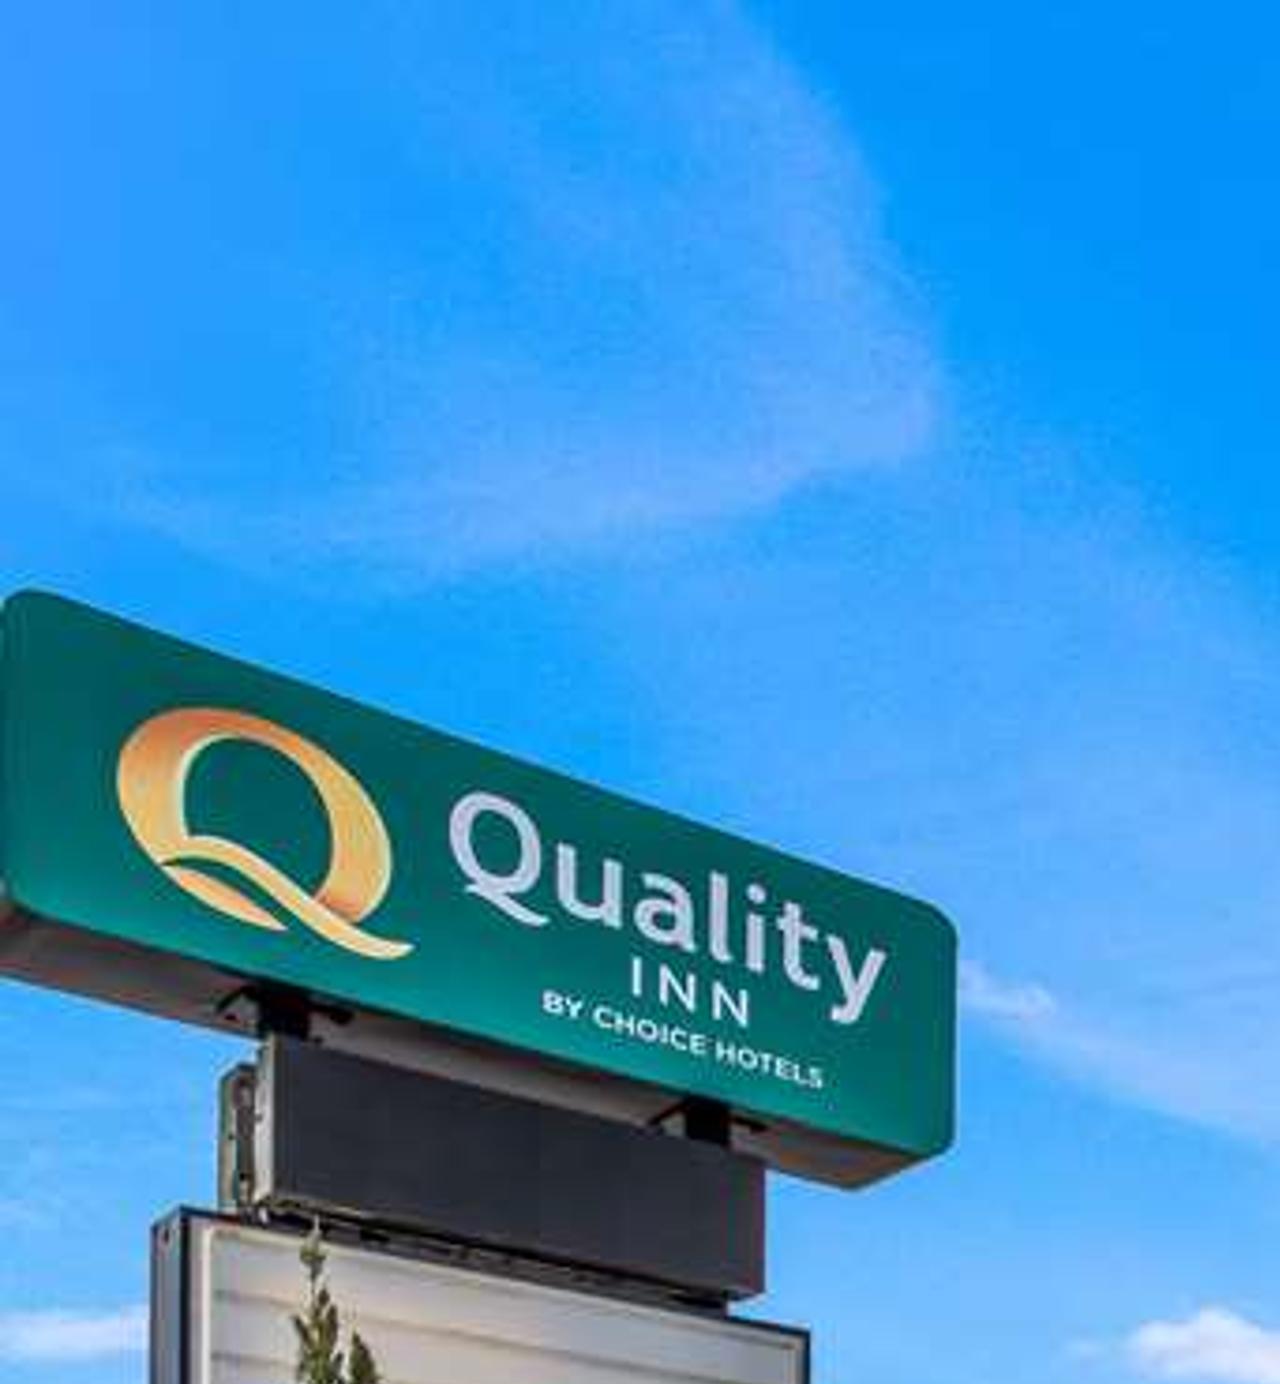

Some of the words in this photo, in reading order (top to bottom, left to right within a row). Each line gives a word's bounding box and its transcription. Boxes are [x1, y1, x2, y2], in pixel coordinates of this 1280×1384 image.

[116, 707, 415, 960] Q
[448, 791, 888, 1025] Quality
[542, 989, 583, 1021] BY
[593, 1005, 706, 1056] CHOICE
[715, 1039, 824, 1089] HOTELS
[631, 956, 749, 1028] INN
